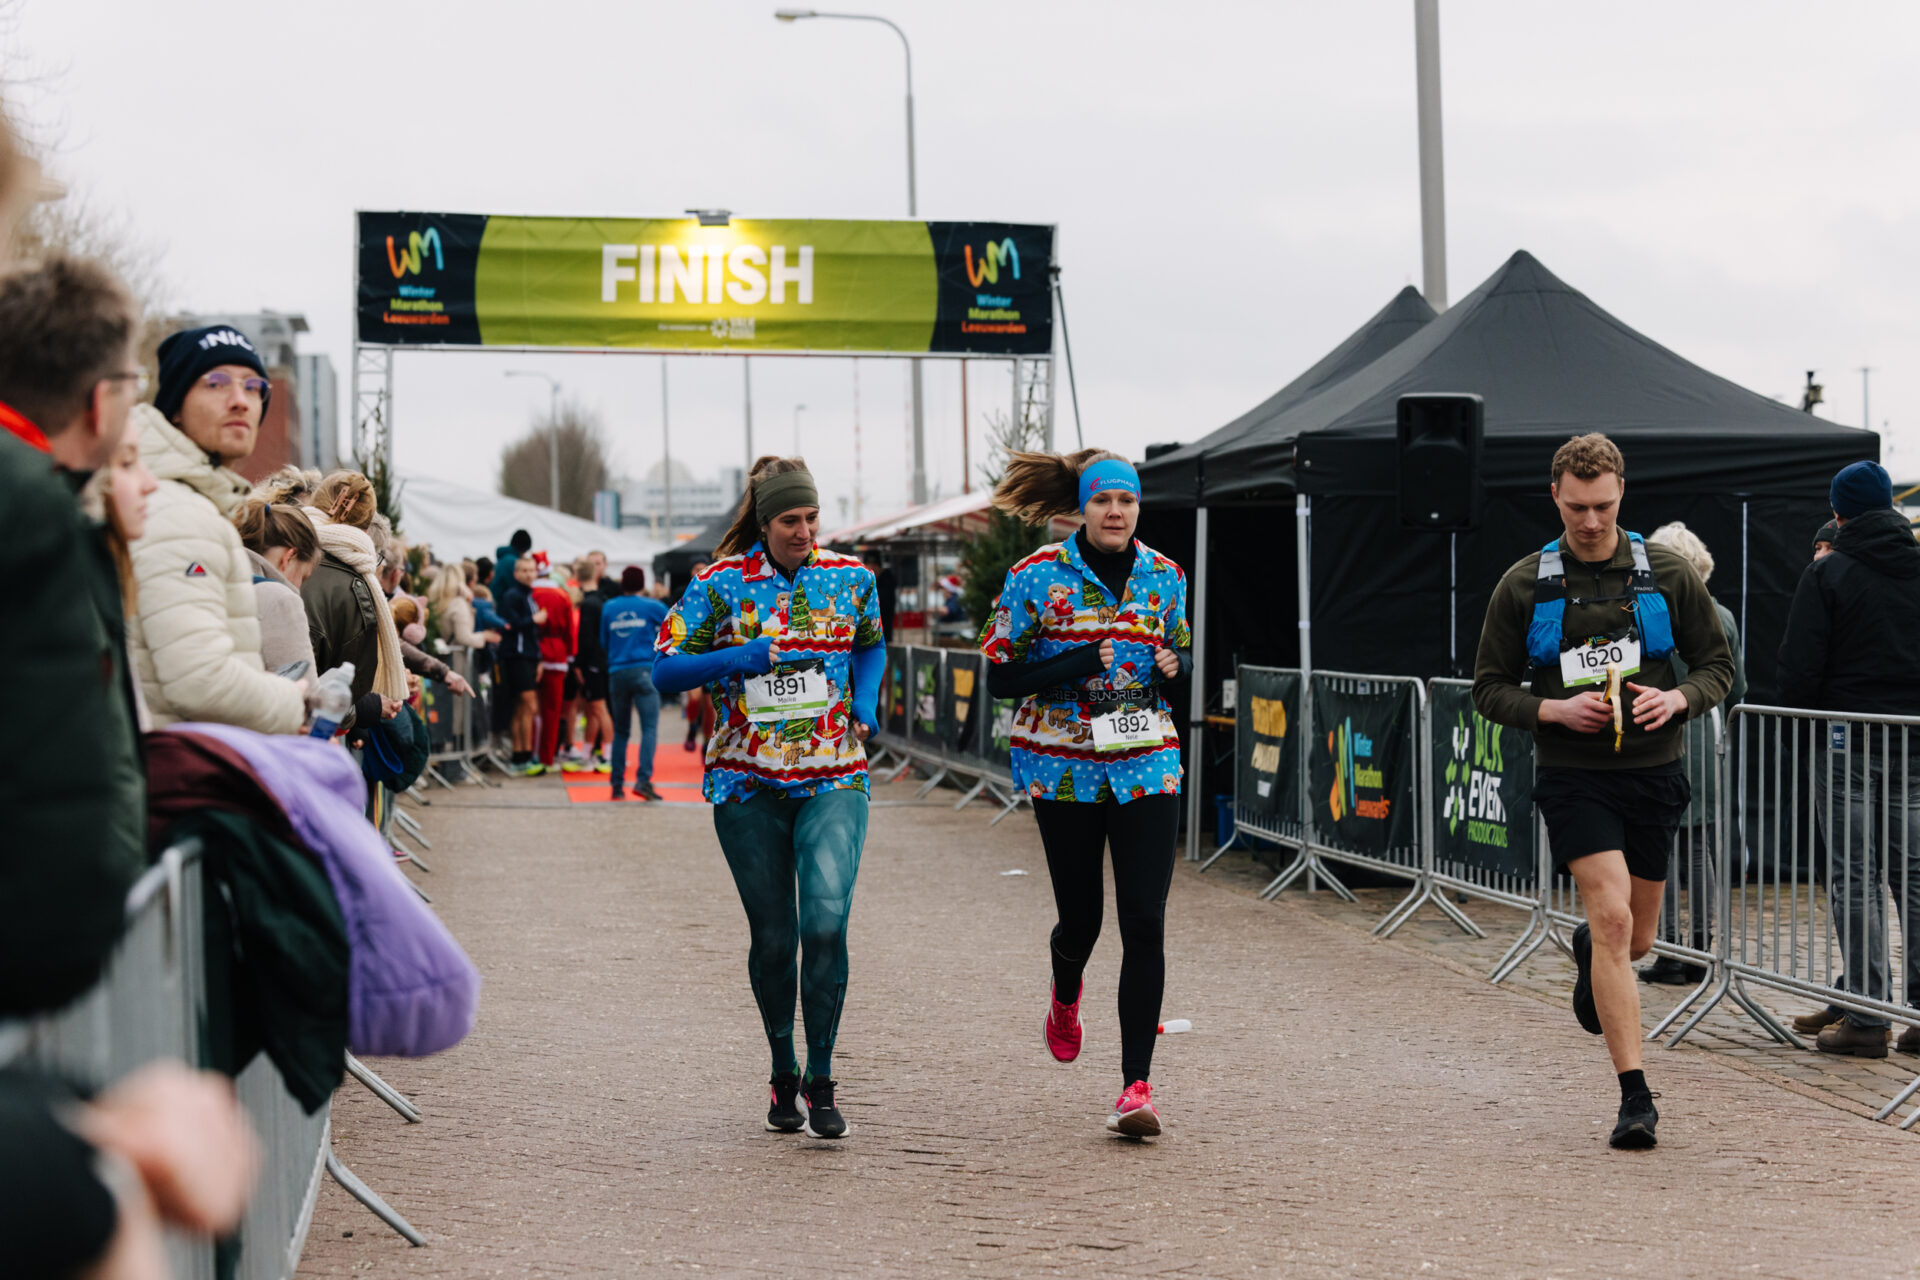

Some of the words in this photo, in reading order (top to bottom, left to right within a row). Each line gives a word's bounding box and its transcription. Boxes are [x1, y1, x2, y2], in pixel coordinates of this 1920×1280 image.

[602, 243, 814, 304] FINISH
[398, 285, 436, 298] Winter
[390, 298, 444, 312] Marathon
[975, 294, 1013, 307] Winter
[383, 311, 450, 325] Leeuwarden
[967, 307, 1021, 320] Marathon
[960, 320, 1027, 334] Leeuwarden
[1577, 646, 1622, 668] 1620
[764, 677, 806, 696] 1891
[1089, 689, 1143, 701] SUNDRIED
[1109, 715, 1150, 734] 1892
